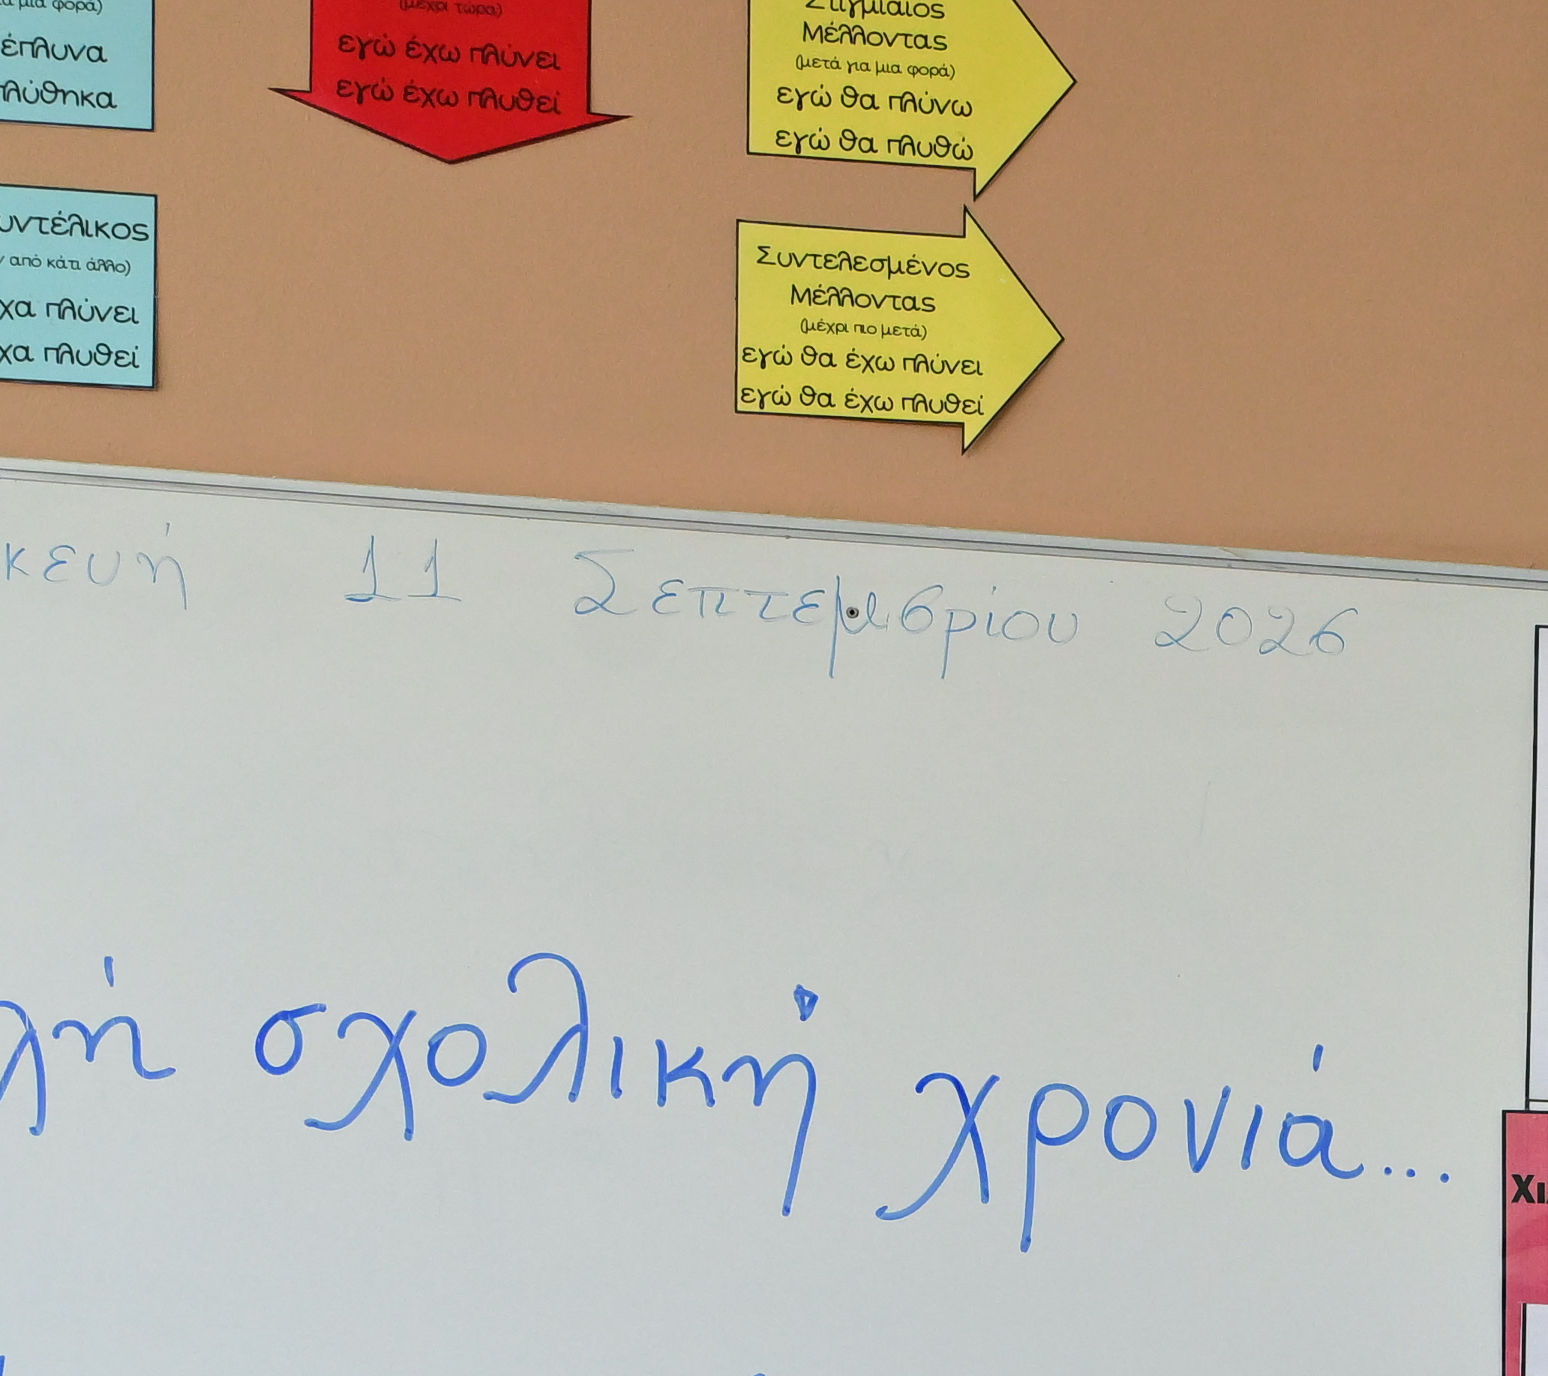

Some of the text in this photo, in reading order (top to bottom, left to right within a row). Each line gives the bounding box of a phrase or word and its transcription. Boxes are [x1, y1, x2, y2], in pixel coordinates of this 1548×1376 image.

[1, 33, 108, 63] έπλυνα
[338, 33, 561, 71] εγώ έχω πλύνει
[802, 21, 948, 51] Μέλλοντας
[795, 54, 956, 81] (μετά για μια φορά)
[336, 77, 561, 115] εγώ έχω πλυθεί
[777, 84, 973, 118] εγώ θα πλύνω
[775, 127, 974, 161] εγώ θα πλυθώ
[10, 252, 42, 268] από
[47, 255, 81, 271] κάτι
[86, 258, 132, 277] άλλο)
[756, 245, 971, 280] Συντελεσμένος
[45, 298, 139, 325] πλύνει
[790, 284, 936, 313] Μέλλοντας
[800, 318, 927, 341] (μέχρι πιο μετά)
[43, 342, 140, 370] πλυθεί
[742, 344, 984, 378] εγώ θα έχω πλύνει
[740, 384, 985, 417] εγώ θα έχω πλυθεί
[1154, 594, 1358, 656] 2026
[254, 952, 818, 1217] σχολική
[876, 1043, 1451, 1253] χρονιά...
